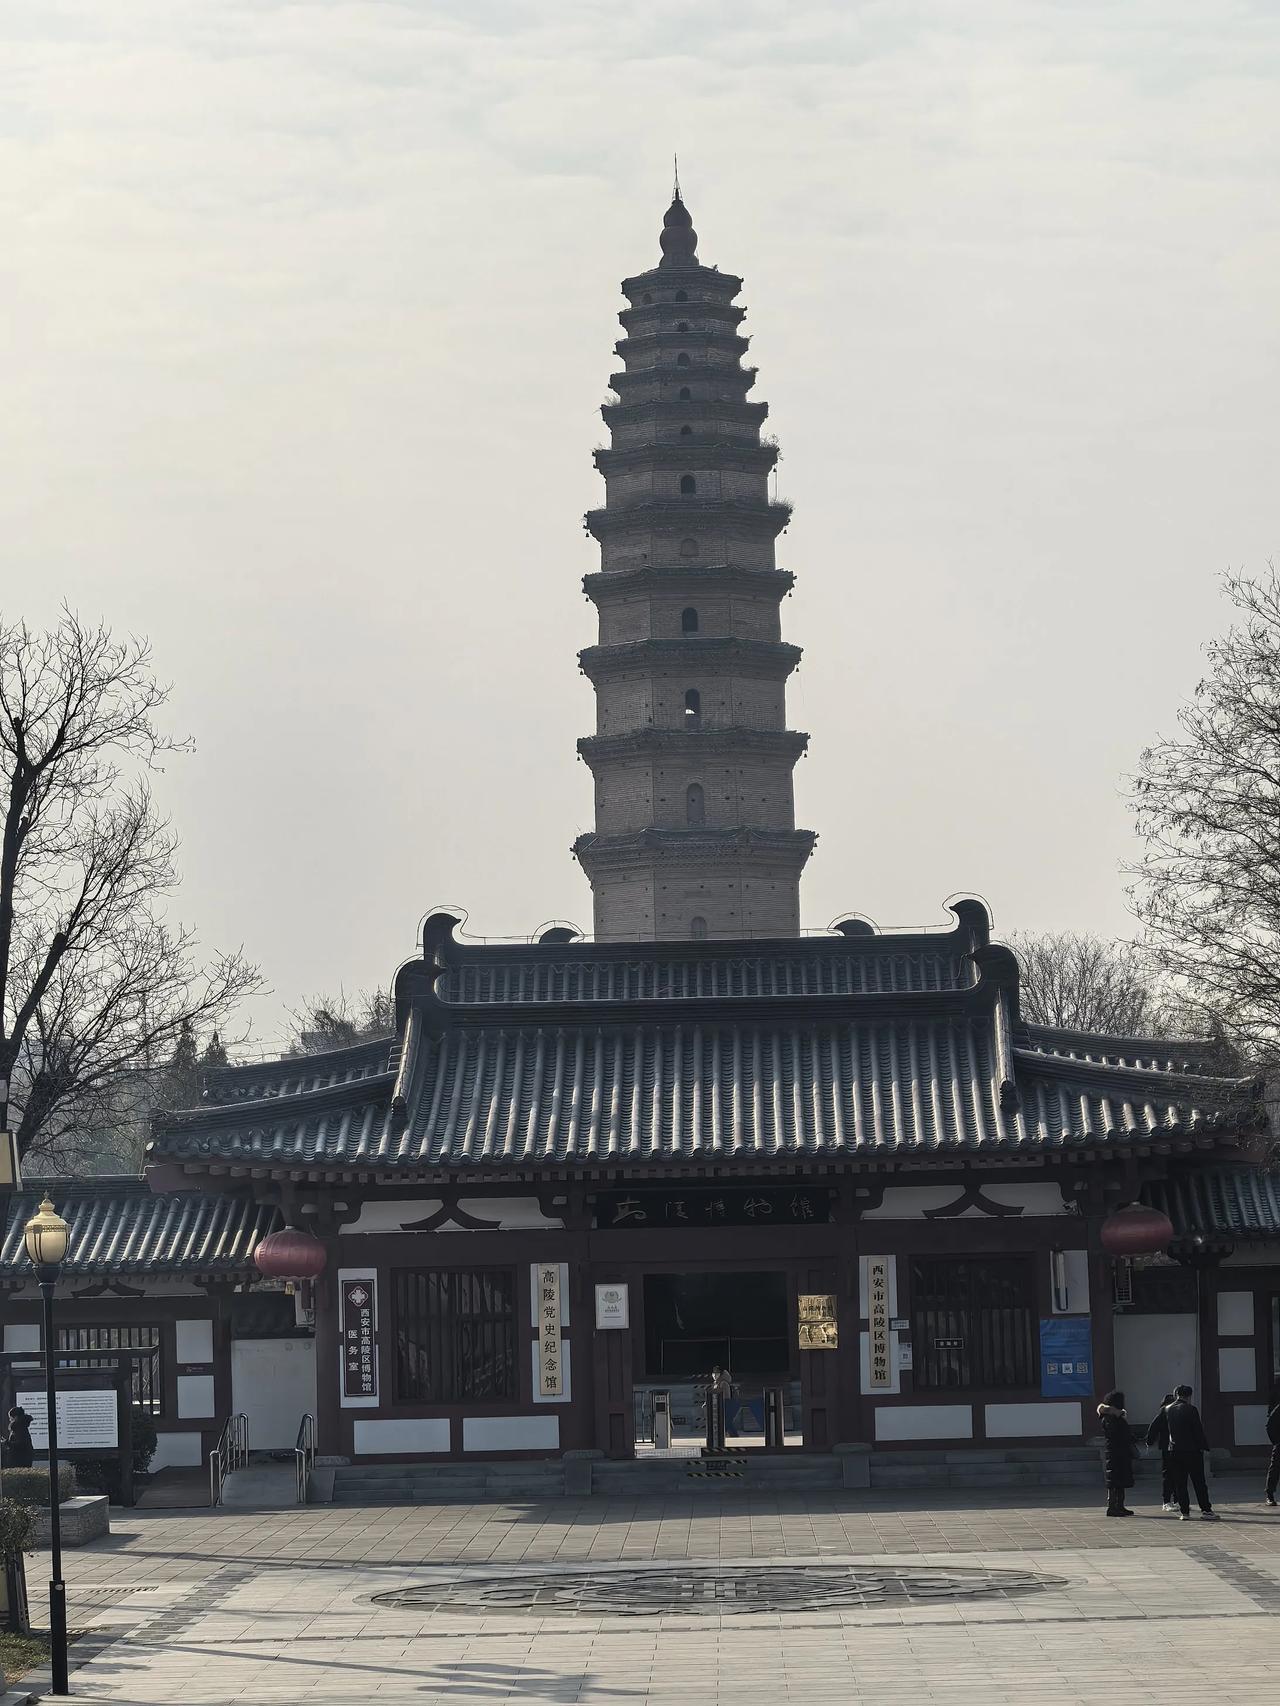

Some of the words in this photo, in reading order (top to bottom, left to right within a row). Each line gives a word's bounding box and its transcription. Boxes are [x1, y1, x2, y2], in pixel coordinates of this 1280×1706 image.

[347, 1329, 359, 1372] 医务室
[360, 1308, 372, 1392] 西安市高陵区博物馆
[542, 1270, 557, 1389] 高陵党史纪念馆
[872, 1264, 886, 1381] 西安市高陵区博物馆
